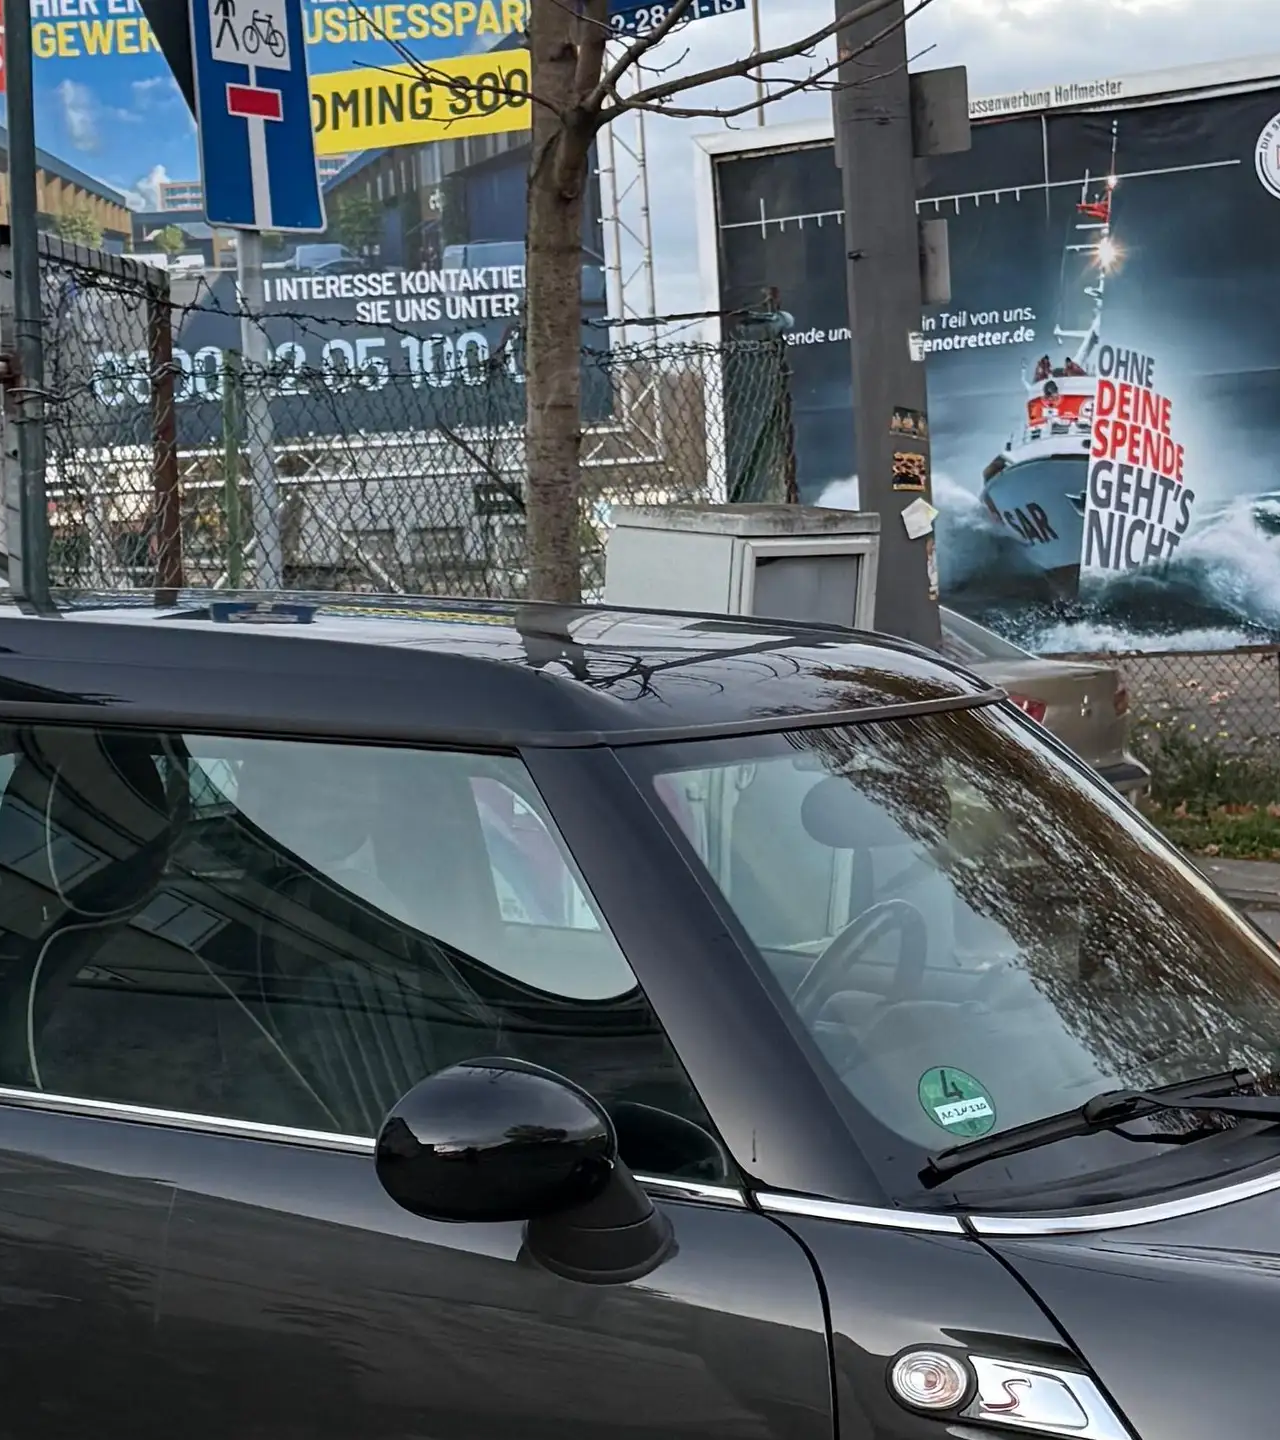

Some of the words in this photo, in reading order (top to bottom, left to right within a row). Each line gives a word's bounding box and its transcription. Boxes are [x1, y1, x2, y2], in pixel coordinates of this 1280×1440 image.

[449, 68, 528, 116] SOO
[969, 90, 1051, 114] ussenwerbung
[1054, 79, 1122, 104] Hoffmeister
[276, 272, 397, 302] INTERESSE
[356, 300, 393, 324] SIE
[395, 297, 442, 323] UNS
[783, 327, 825, 347] ende
[940, 310, 967, 330] Teil
[970, 308, 1000, 327] von
[1003, 306, 1036, 323] uns.
[924, 326, 1036, 354] enotretter.de
[1098, 345, 1155, 388] OHNE
[1096, 379, 1172, 435] DEINE
[1092, 419, 1185, 482] SPENDE
[1090, 460, 1195, 534] GEHT'S
[1003, 502, 1059, 545] SAR
[1085, 510, 1180, 570] NICHT
[940, 1069, 966, 1100] 4
[979, 1378, 1032, 1412] S
